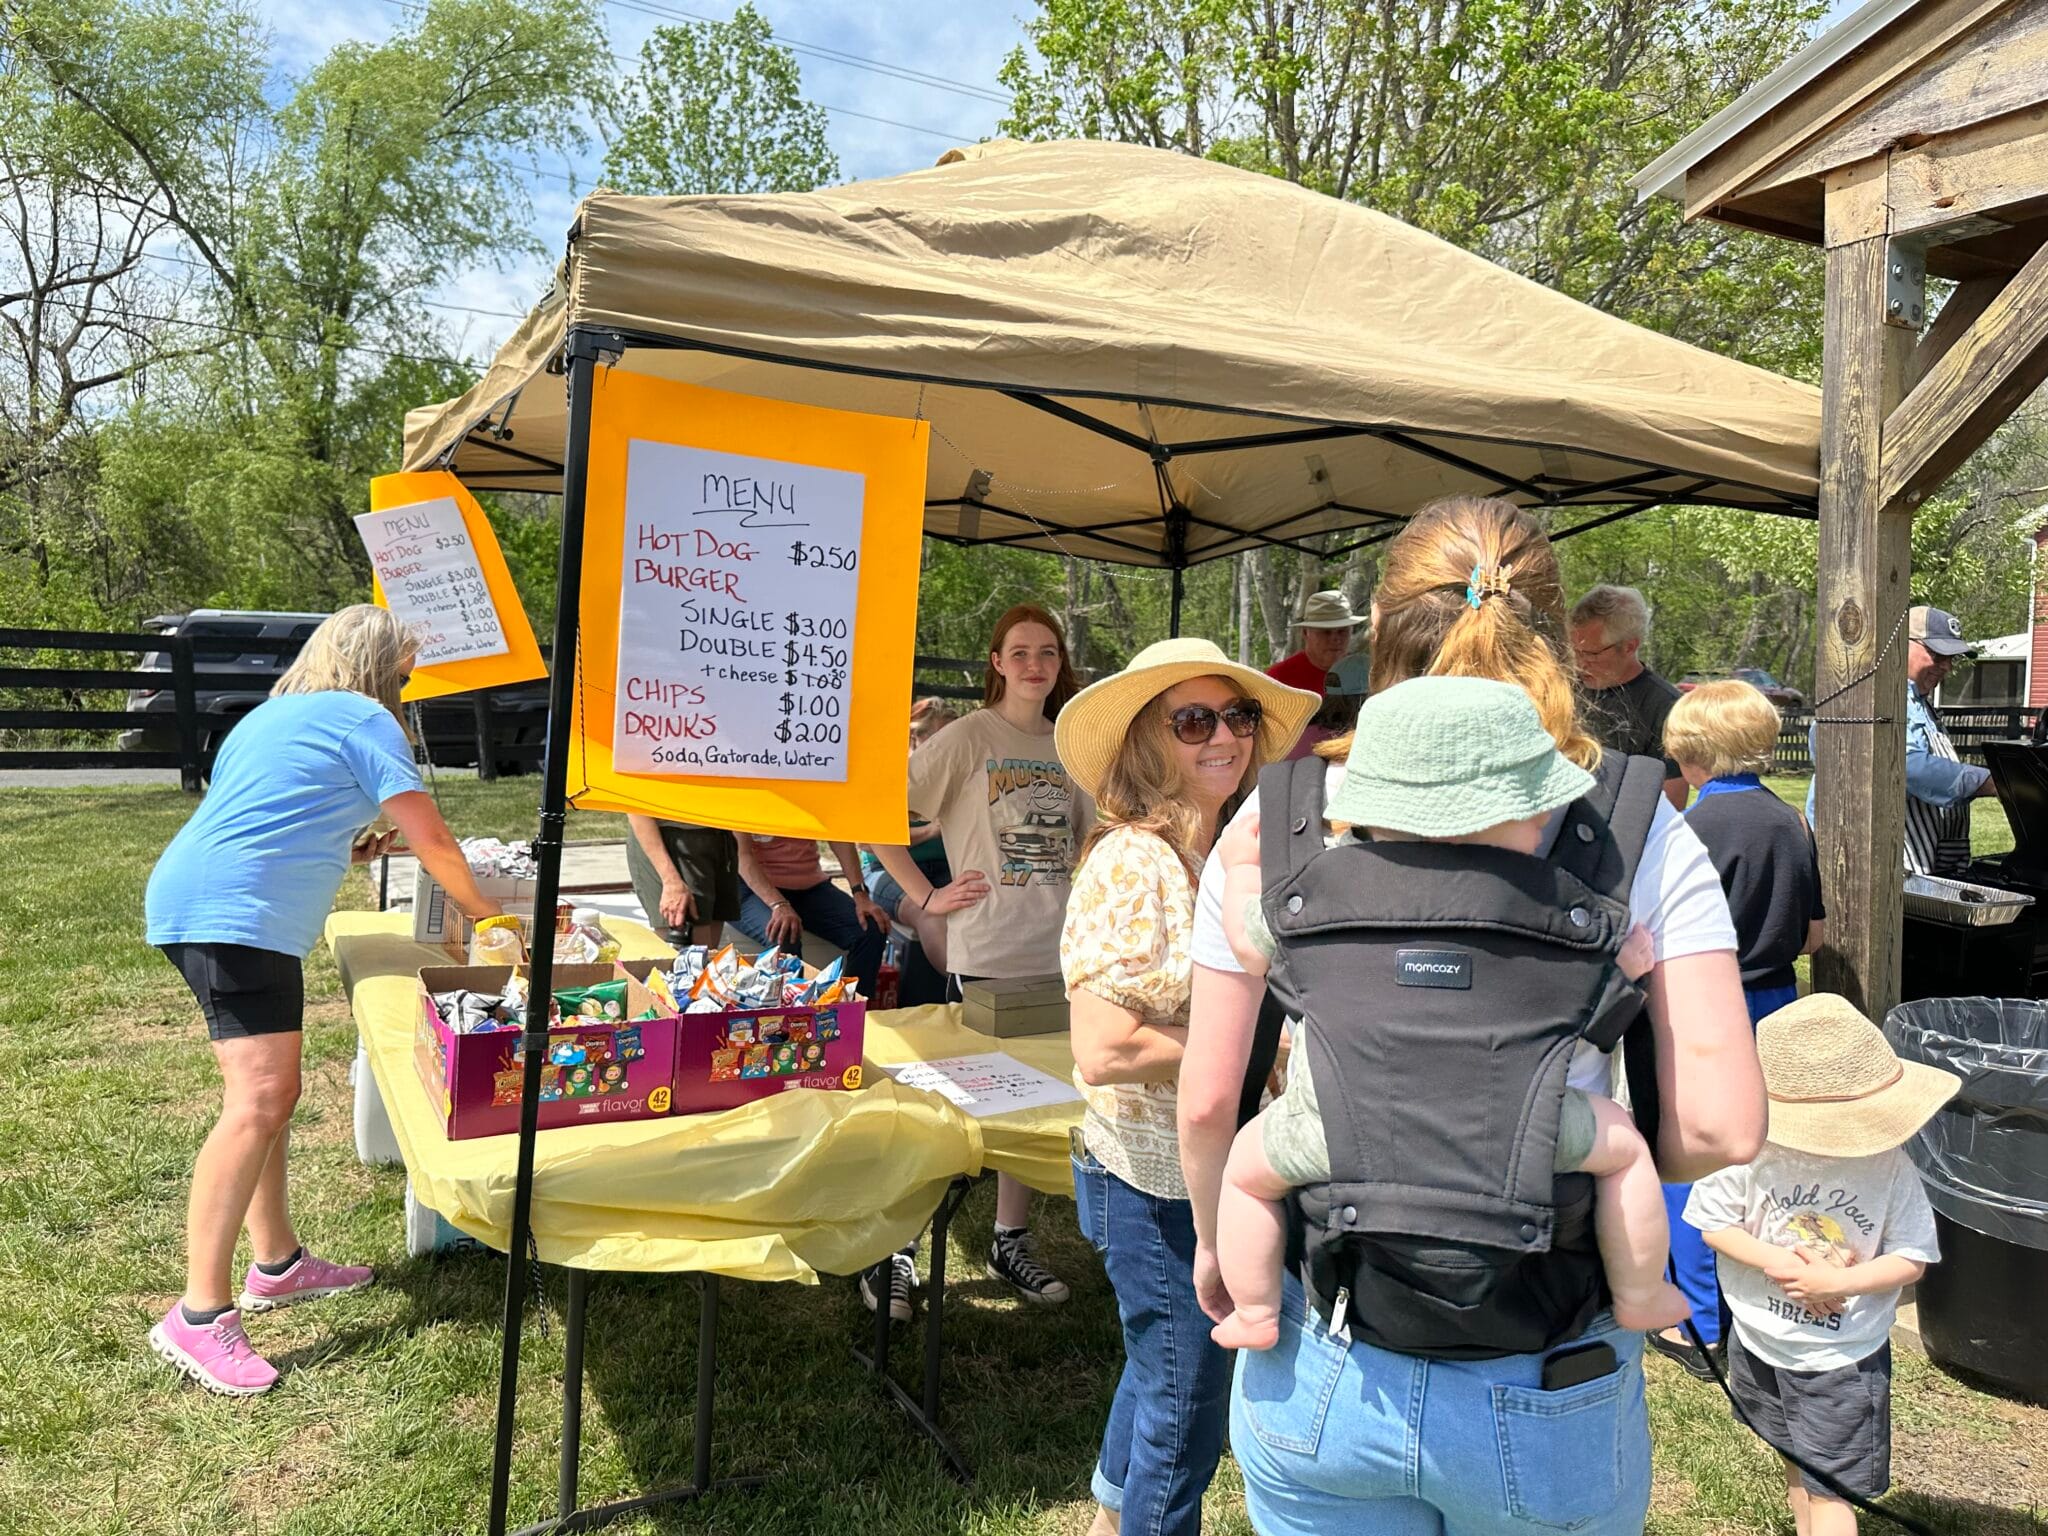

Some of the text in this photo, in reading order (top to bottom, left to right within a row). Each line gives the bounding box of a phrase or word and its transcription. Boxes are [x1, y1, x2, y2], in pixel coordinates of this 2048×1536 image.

[704, 473, 795, 515] MENU
[383, 512, 431, 536] MENU
[396, 544, 422, 559] DOG
[639, 524, 857, 571] HOT DOG $2.50
[380, 562, 428, 581] BURGER
[635, 558, 747, 604] BURGER
[408, 588, 450, 606] DOUBLE
[681, 598, 847, 639] SINGLE $3.00
[680, 629, 848, 668] DOUBLE $4.50
[626, 677, 840, 718] CHIPS $1.00
[625, 711, 842, 744] DRINKS $2.00
[784, 750, 835, 767] Water
[1001, 862, 1033, 887] 17
[803, 1075, 841, 1089] flavor
[847, 1068, 860, 1081] 42
[603, 1098, 646, 1113] flavor
[653, 1090, 668, 1104] 42
[1761, 1184, 1875, 1236] Hold Your
